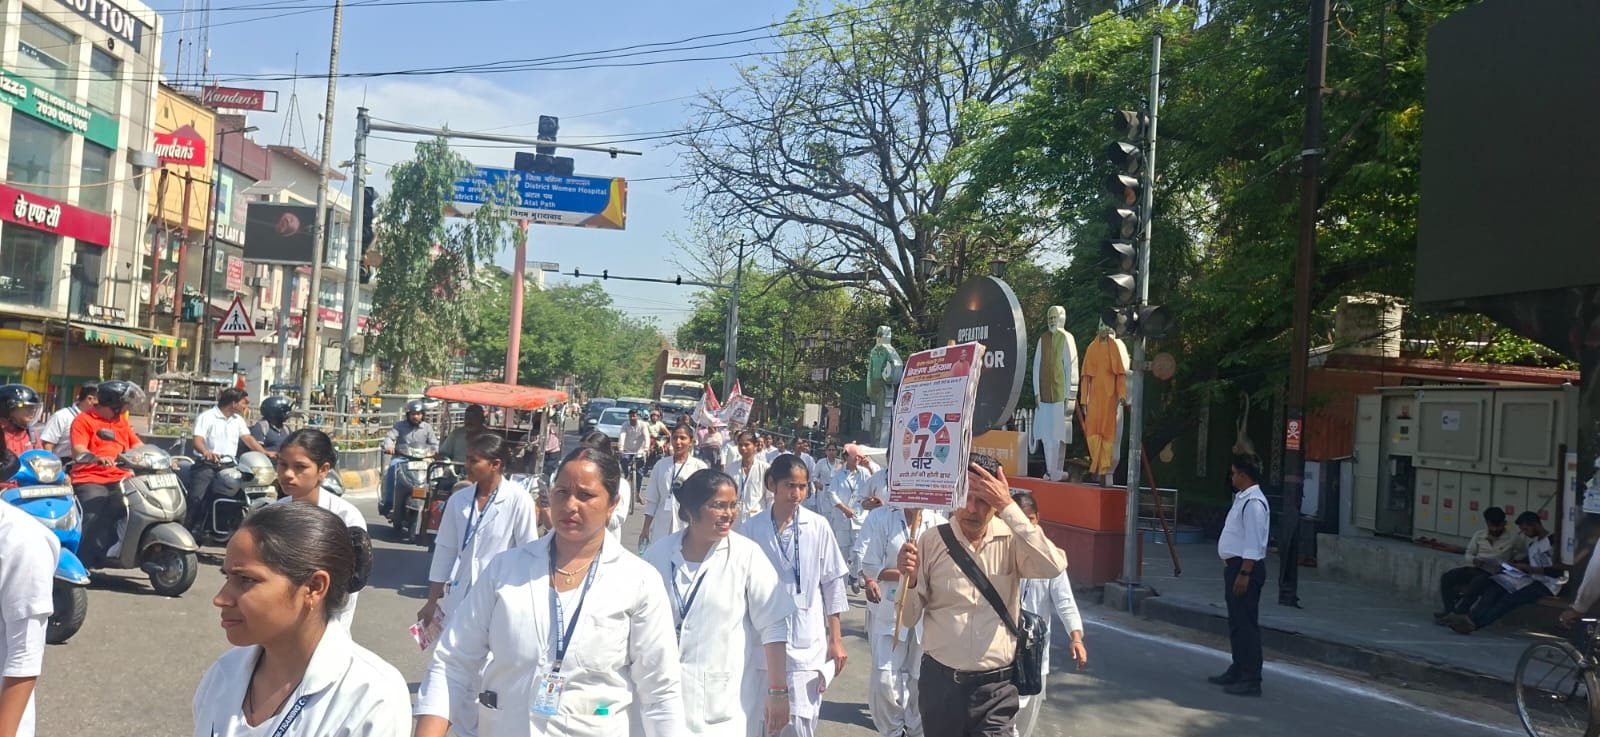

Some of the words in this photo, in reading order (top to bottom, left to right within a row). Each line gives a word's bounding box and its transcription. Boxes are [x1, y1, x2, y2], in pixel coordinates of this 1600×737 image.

[204, 90, 259, 105] Kundan's
[66, 102, 92, 120] DELIVERY
[524, 182, 550, 190] District
[551, 184, 577, 192] Women
[577, 186, 607, 196] Hospital
[15, 193, 29, 218] के
[28, 203, 48, 223] एफ
[46, 204, 62, 228] सी
[540, 200, 556, 208] Path
[510, 209, 529, 217] निगम
[531, 210, 562, 221] मुरादाबाद
[957, 325, 989, 342] OPERATION
[671, 357, 701, 369] AXIS
[914, 434, 930, 457] 7
[911, 457, 934, 469] वार
